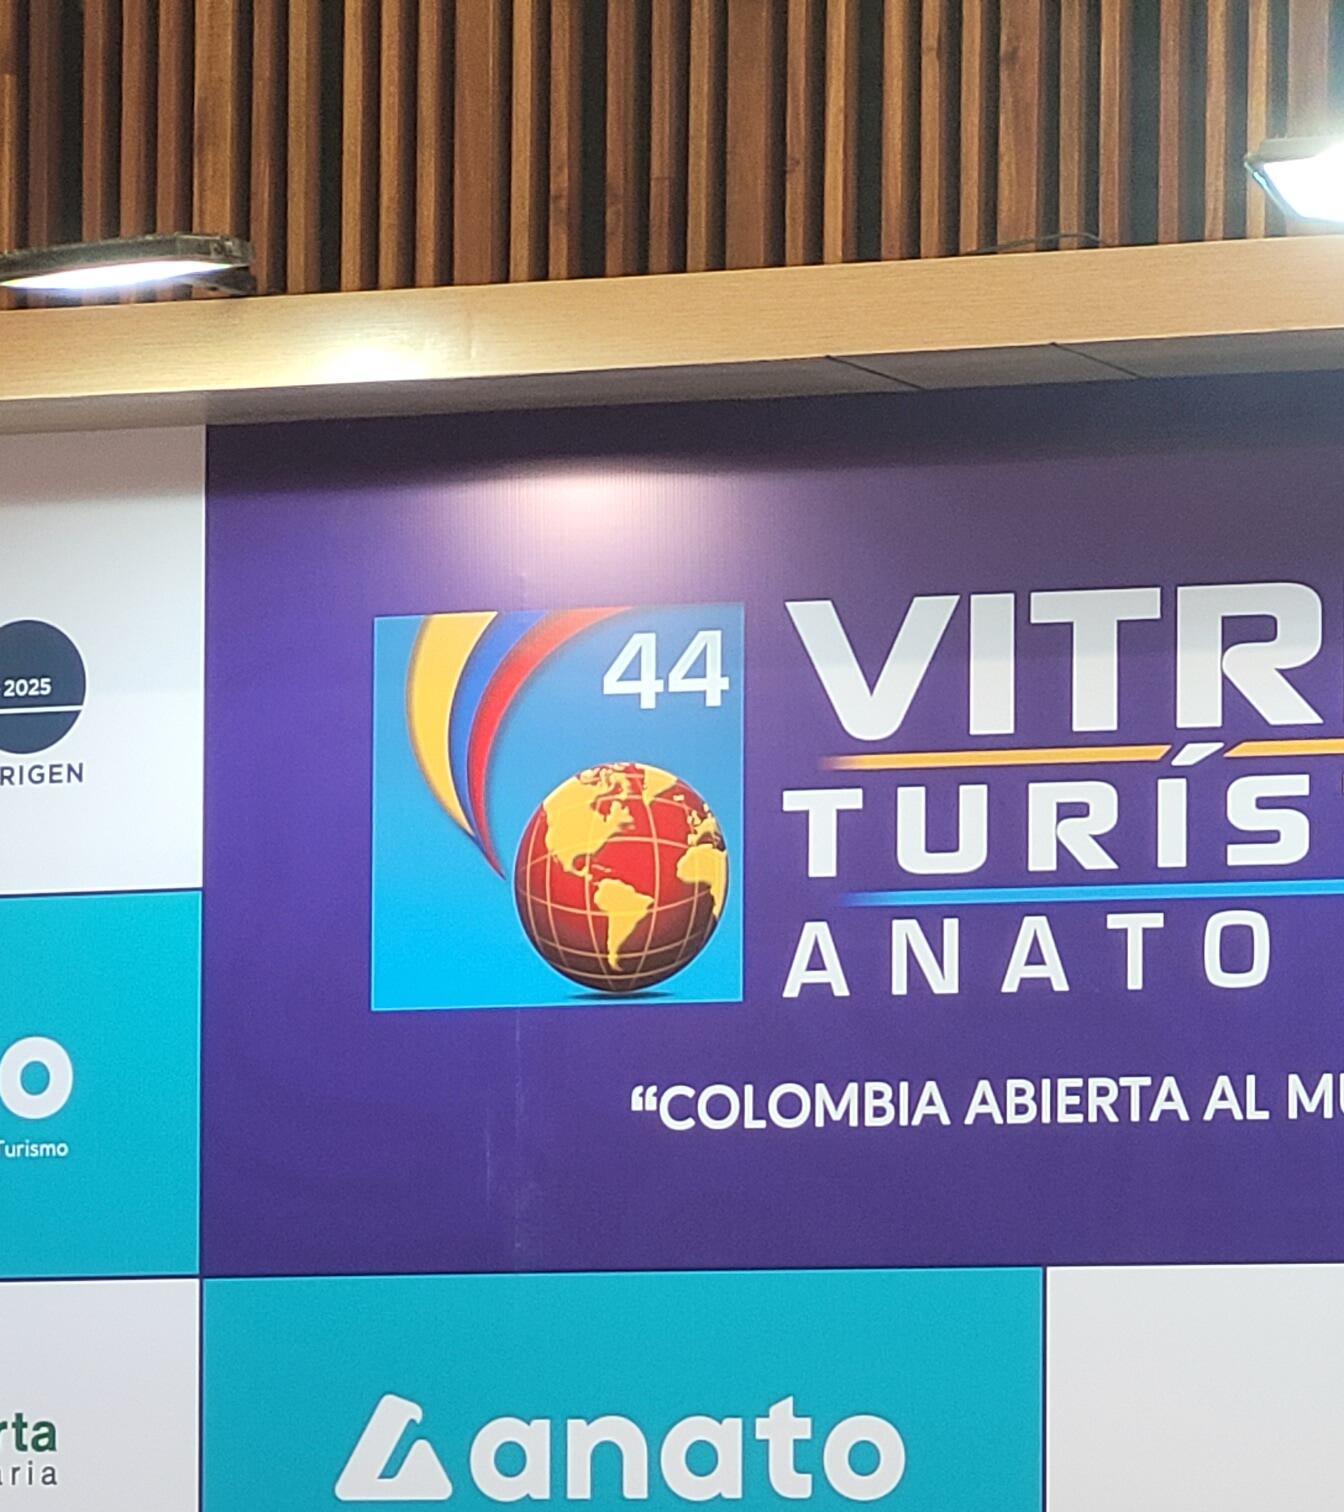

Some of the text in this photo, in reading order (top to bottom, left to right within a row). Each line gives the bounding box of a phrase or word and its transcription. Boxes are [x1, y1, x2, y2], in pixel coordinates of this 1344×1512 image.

[3, 677, 52, 697] 2025
[602, 628, 730, 710] 44
[781, 909, 1272, 999] ANATO
[631, 1080, 951, 1131] “COLOMBIA
[964, 1076, 1190, 1125] ABIERTA
[1203, 1074, 1270, 1121] AL
[469, 1395, 906, 1503] anato
